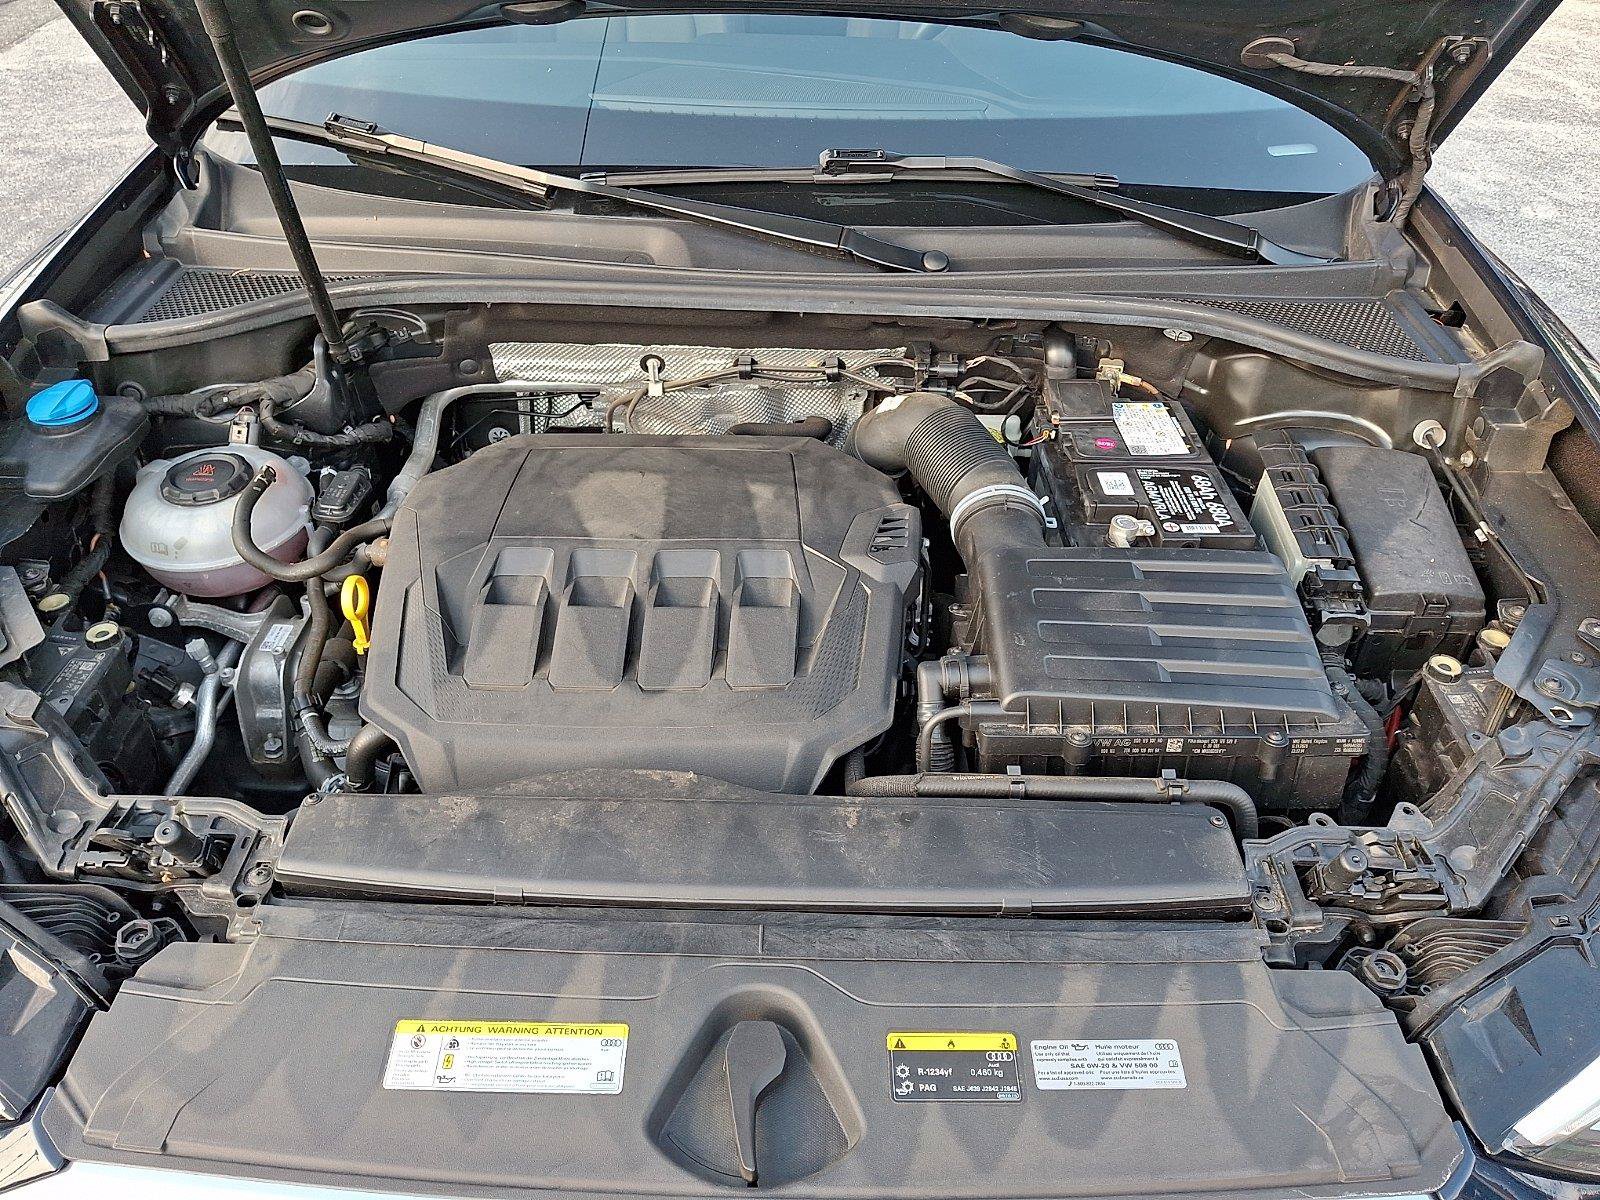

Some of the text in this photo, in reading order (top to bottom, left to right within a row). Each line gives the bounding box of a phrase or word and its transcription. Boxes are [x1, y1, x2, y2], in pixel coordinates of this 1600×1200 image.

[1191, 474, 1219, 500] 68Ah
[1205, 501, 1234, 528] 680A
[1092, 738, 1112, 747] VW
[1114, 738, 1132, 747] AG
[431, 1025, 603, 1036] ACHTUNG WARNING ATTENTION
[917, 1067, 953, 1078] R-1234yf
[994, 1068, 1004, 1078] kg
[918, 1083, 937, 1092] PAG
